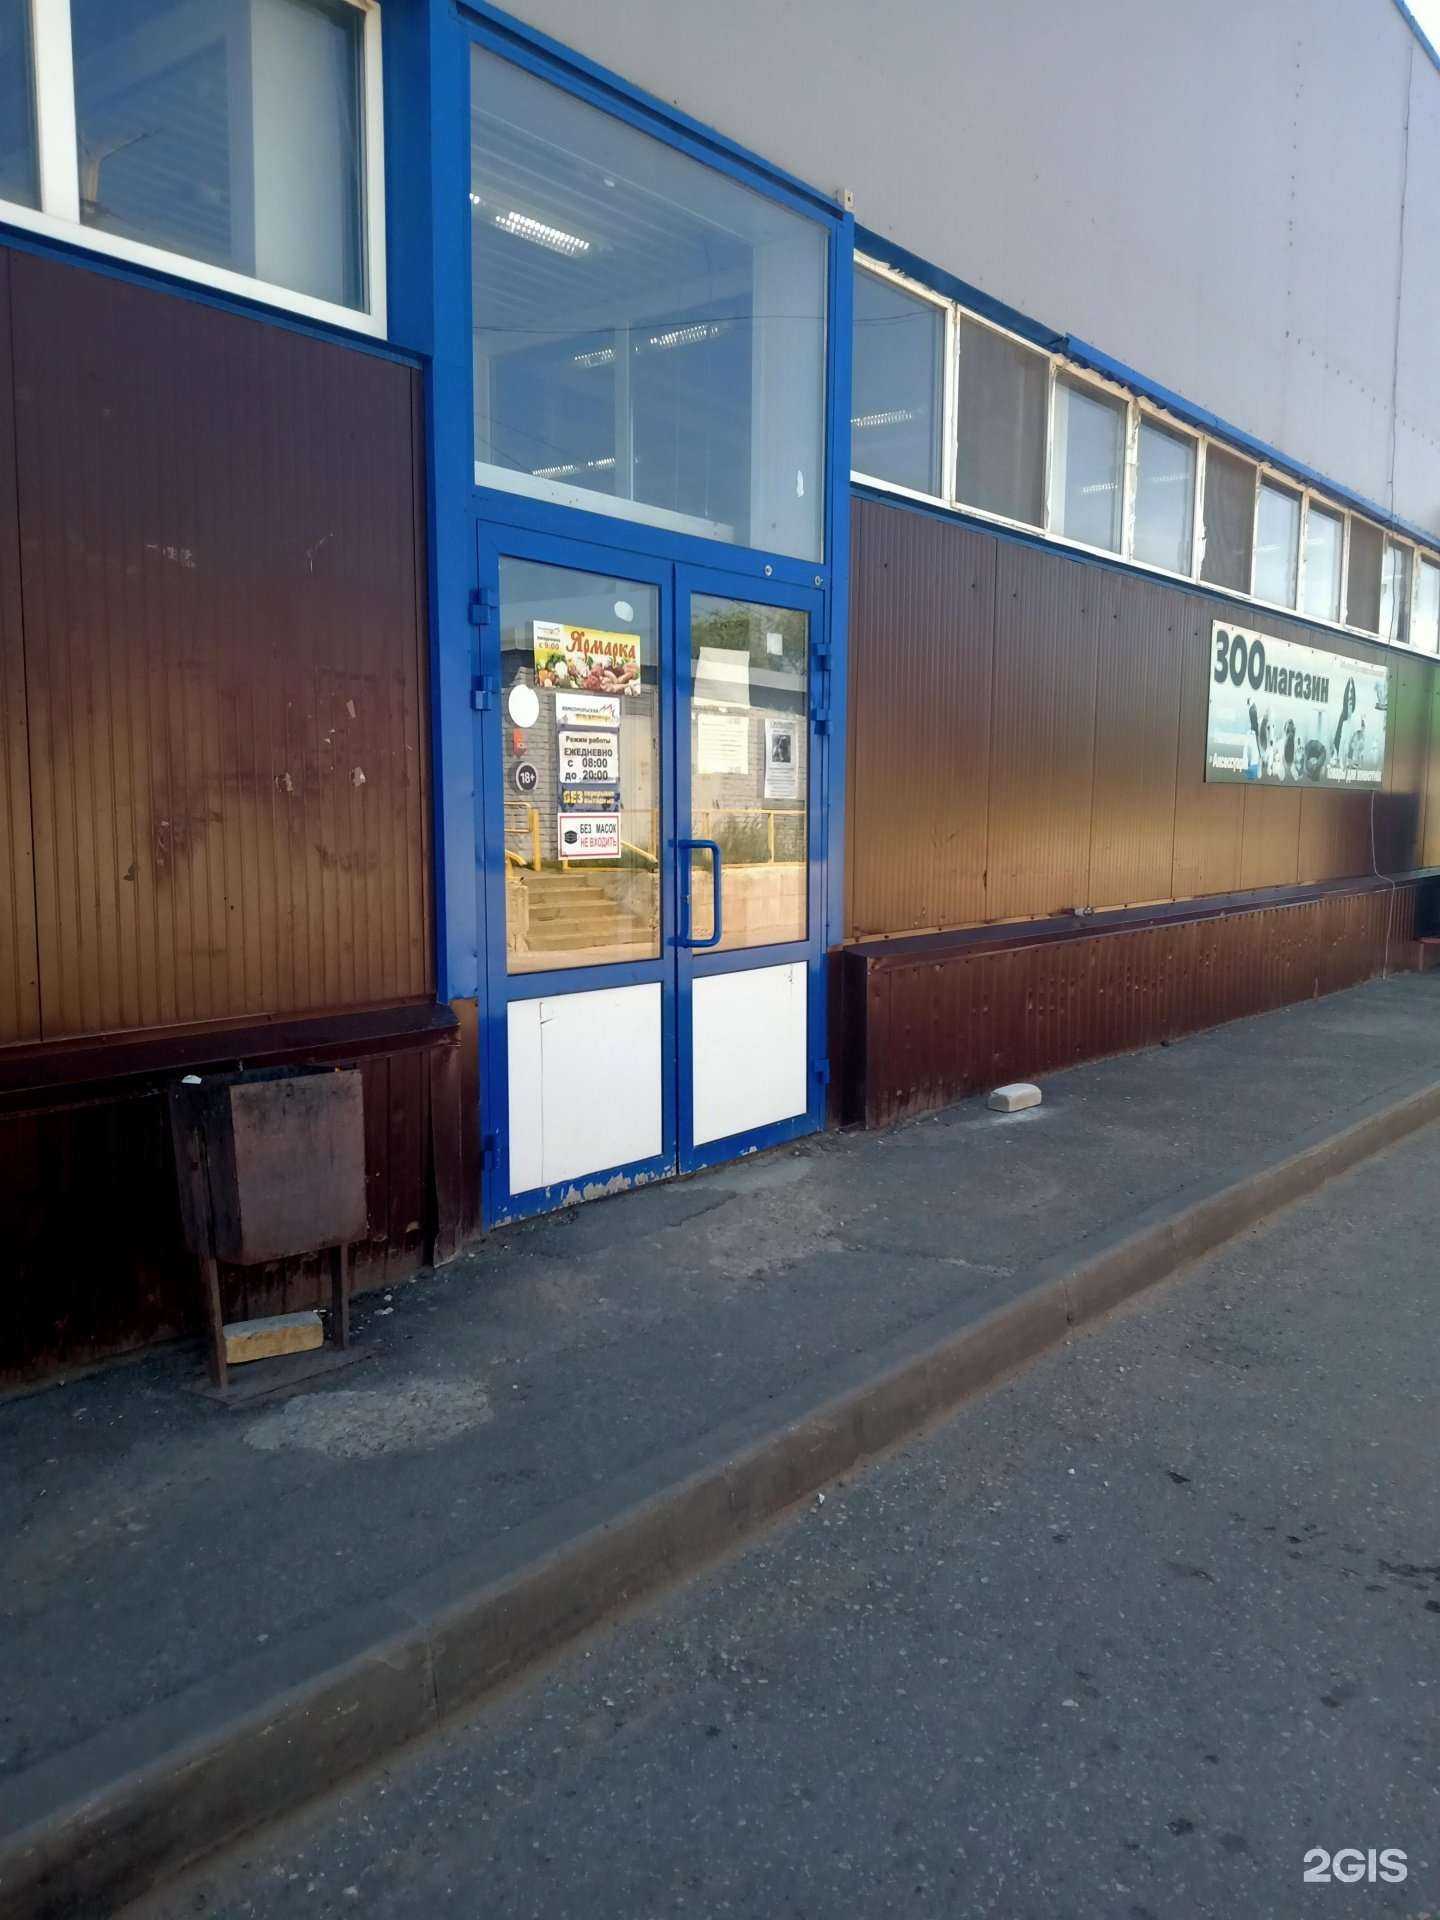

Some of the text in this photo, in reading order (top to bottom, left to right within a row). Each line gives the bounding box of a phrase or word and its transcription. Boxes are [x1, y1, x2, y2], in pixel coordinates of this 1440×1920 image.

[566, 630, 636, 668] Ярмарка
[565, 735, 611, 745] Режим работы
[563, 747, 613, 757] ЕЖЕДНЕВНО
[582, 757, 608, 768] 08:00
[520, 771, 536, 784] 18+
[565, 769, 608, 782] до 20:00
[580, 823, 617, 834] БЕЗ МАСОК
[580, 837, 617, 848] НЕ ВХОДИТЬ
